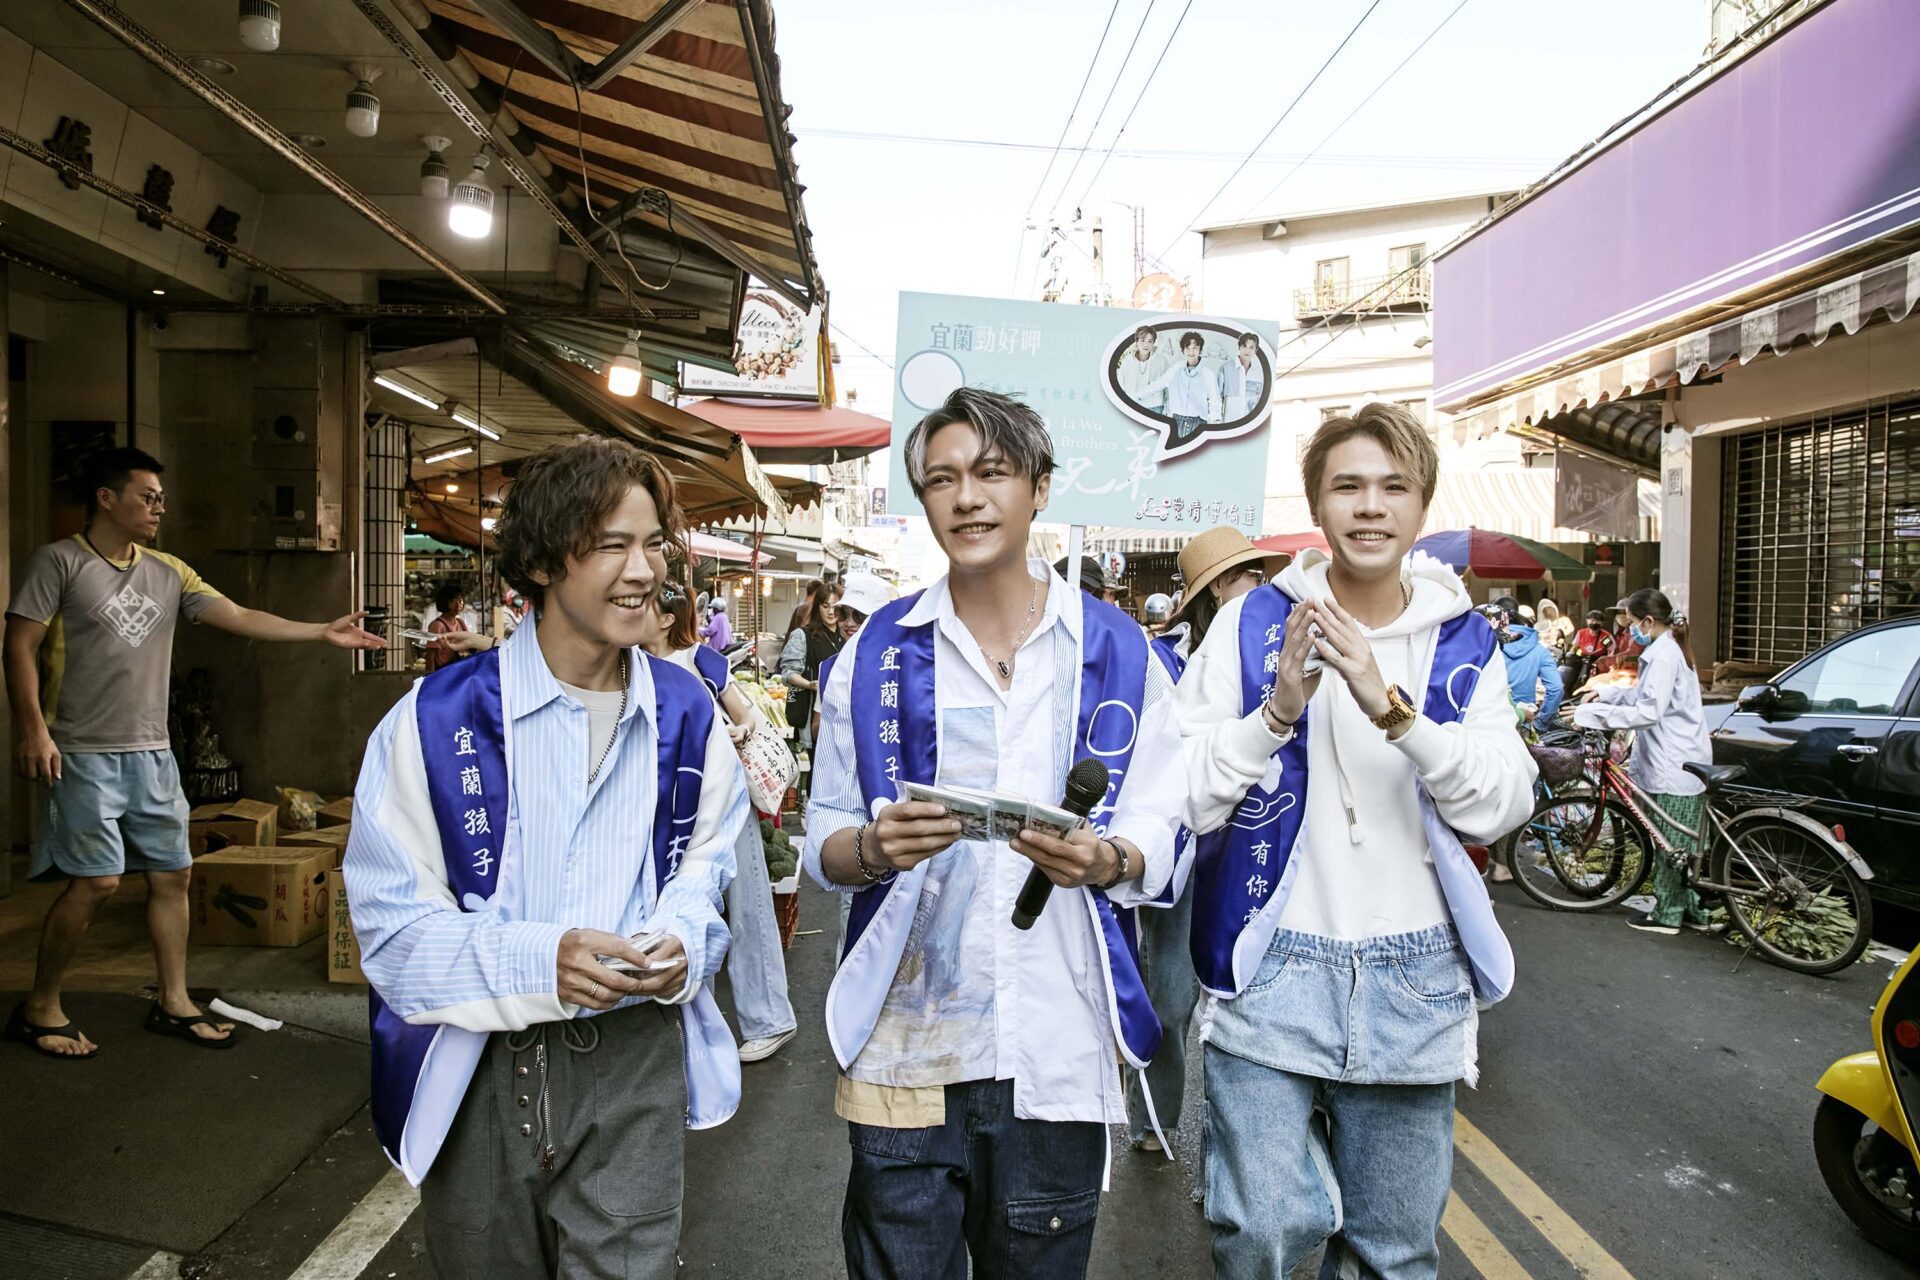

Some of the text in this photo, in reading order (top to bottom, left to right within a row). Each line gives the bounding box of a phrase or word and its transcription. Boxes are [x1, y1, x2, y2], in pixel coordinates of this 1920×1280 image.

[930, 322, 1041, 357] 宜蘭勁好呷
[1060, 435, 1119, 450] Brothers
[1062, 417, 1103, 432] Li Wu
[878, 646, 901, 783] 宜蘭孩子
[453, 726, 495, 877] 宜蘭孩子
[333, 888, 352, 970] 品質保証
